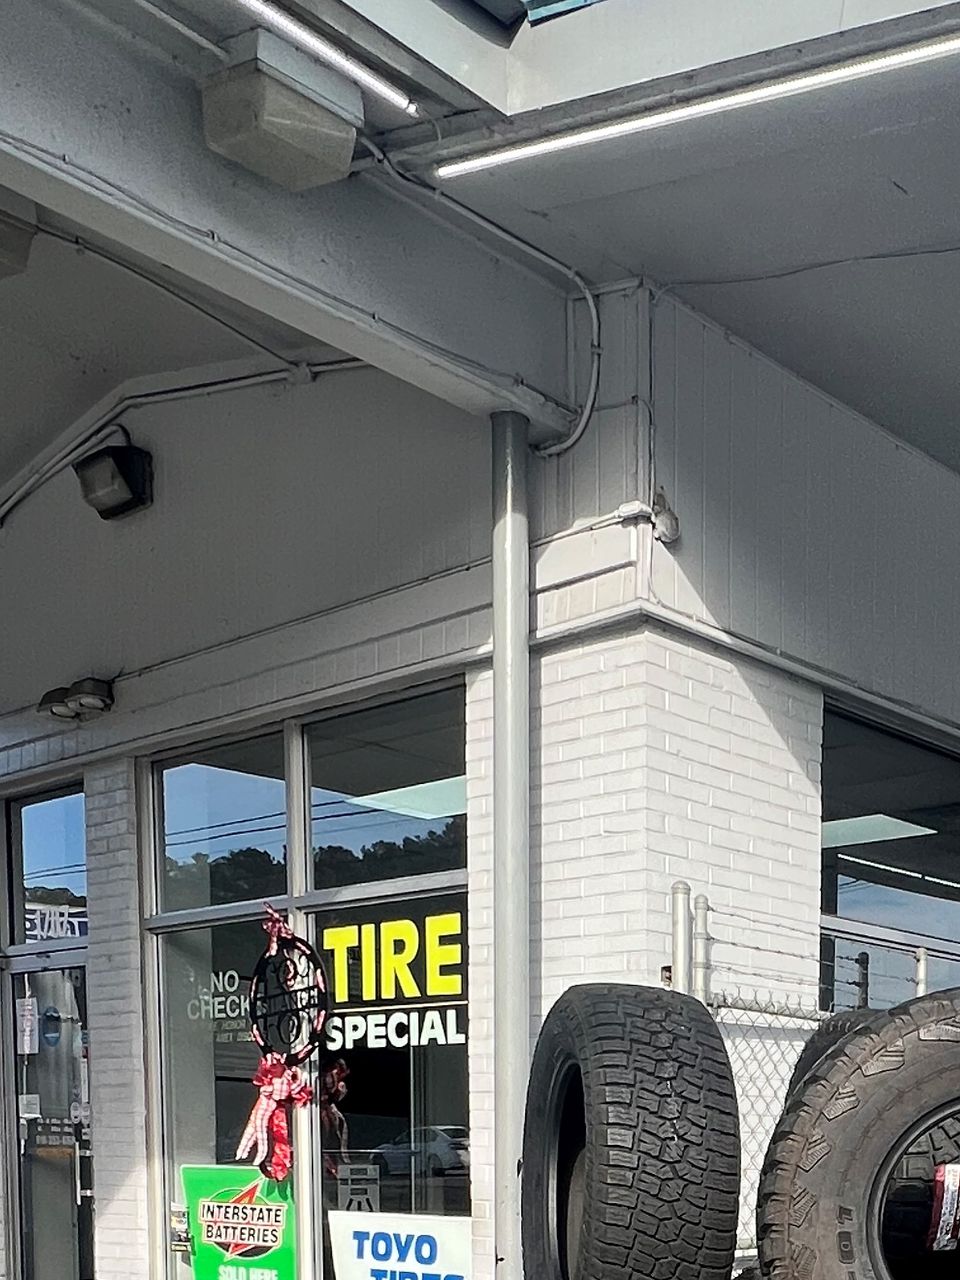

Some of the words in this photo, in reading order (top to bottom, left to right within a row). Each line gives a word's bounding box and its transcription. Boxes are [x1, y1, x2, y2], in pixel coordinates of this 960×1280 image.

[323, 912, 462, 1003] TIRE
[210, 970, 239, 992] NO
[325, 1009, 466, 1051] SPECIAL
[202, 1203, 282, 1223] INTERSTATE
[206, 1225, 278, 1243] BATTERIES
[352, 1230, 438, 1265] TOYO
